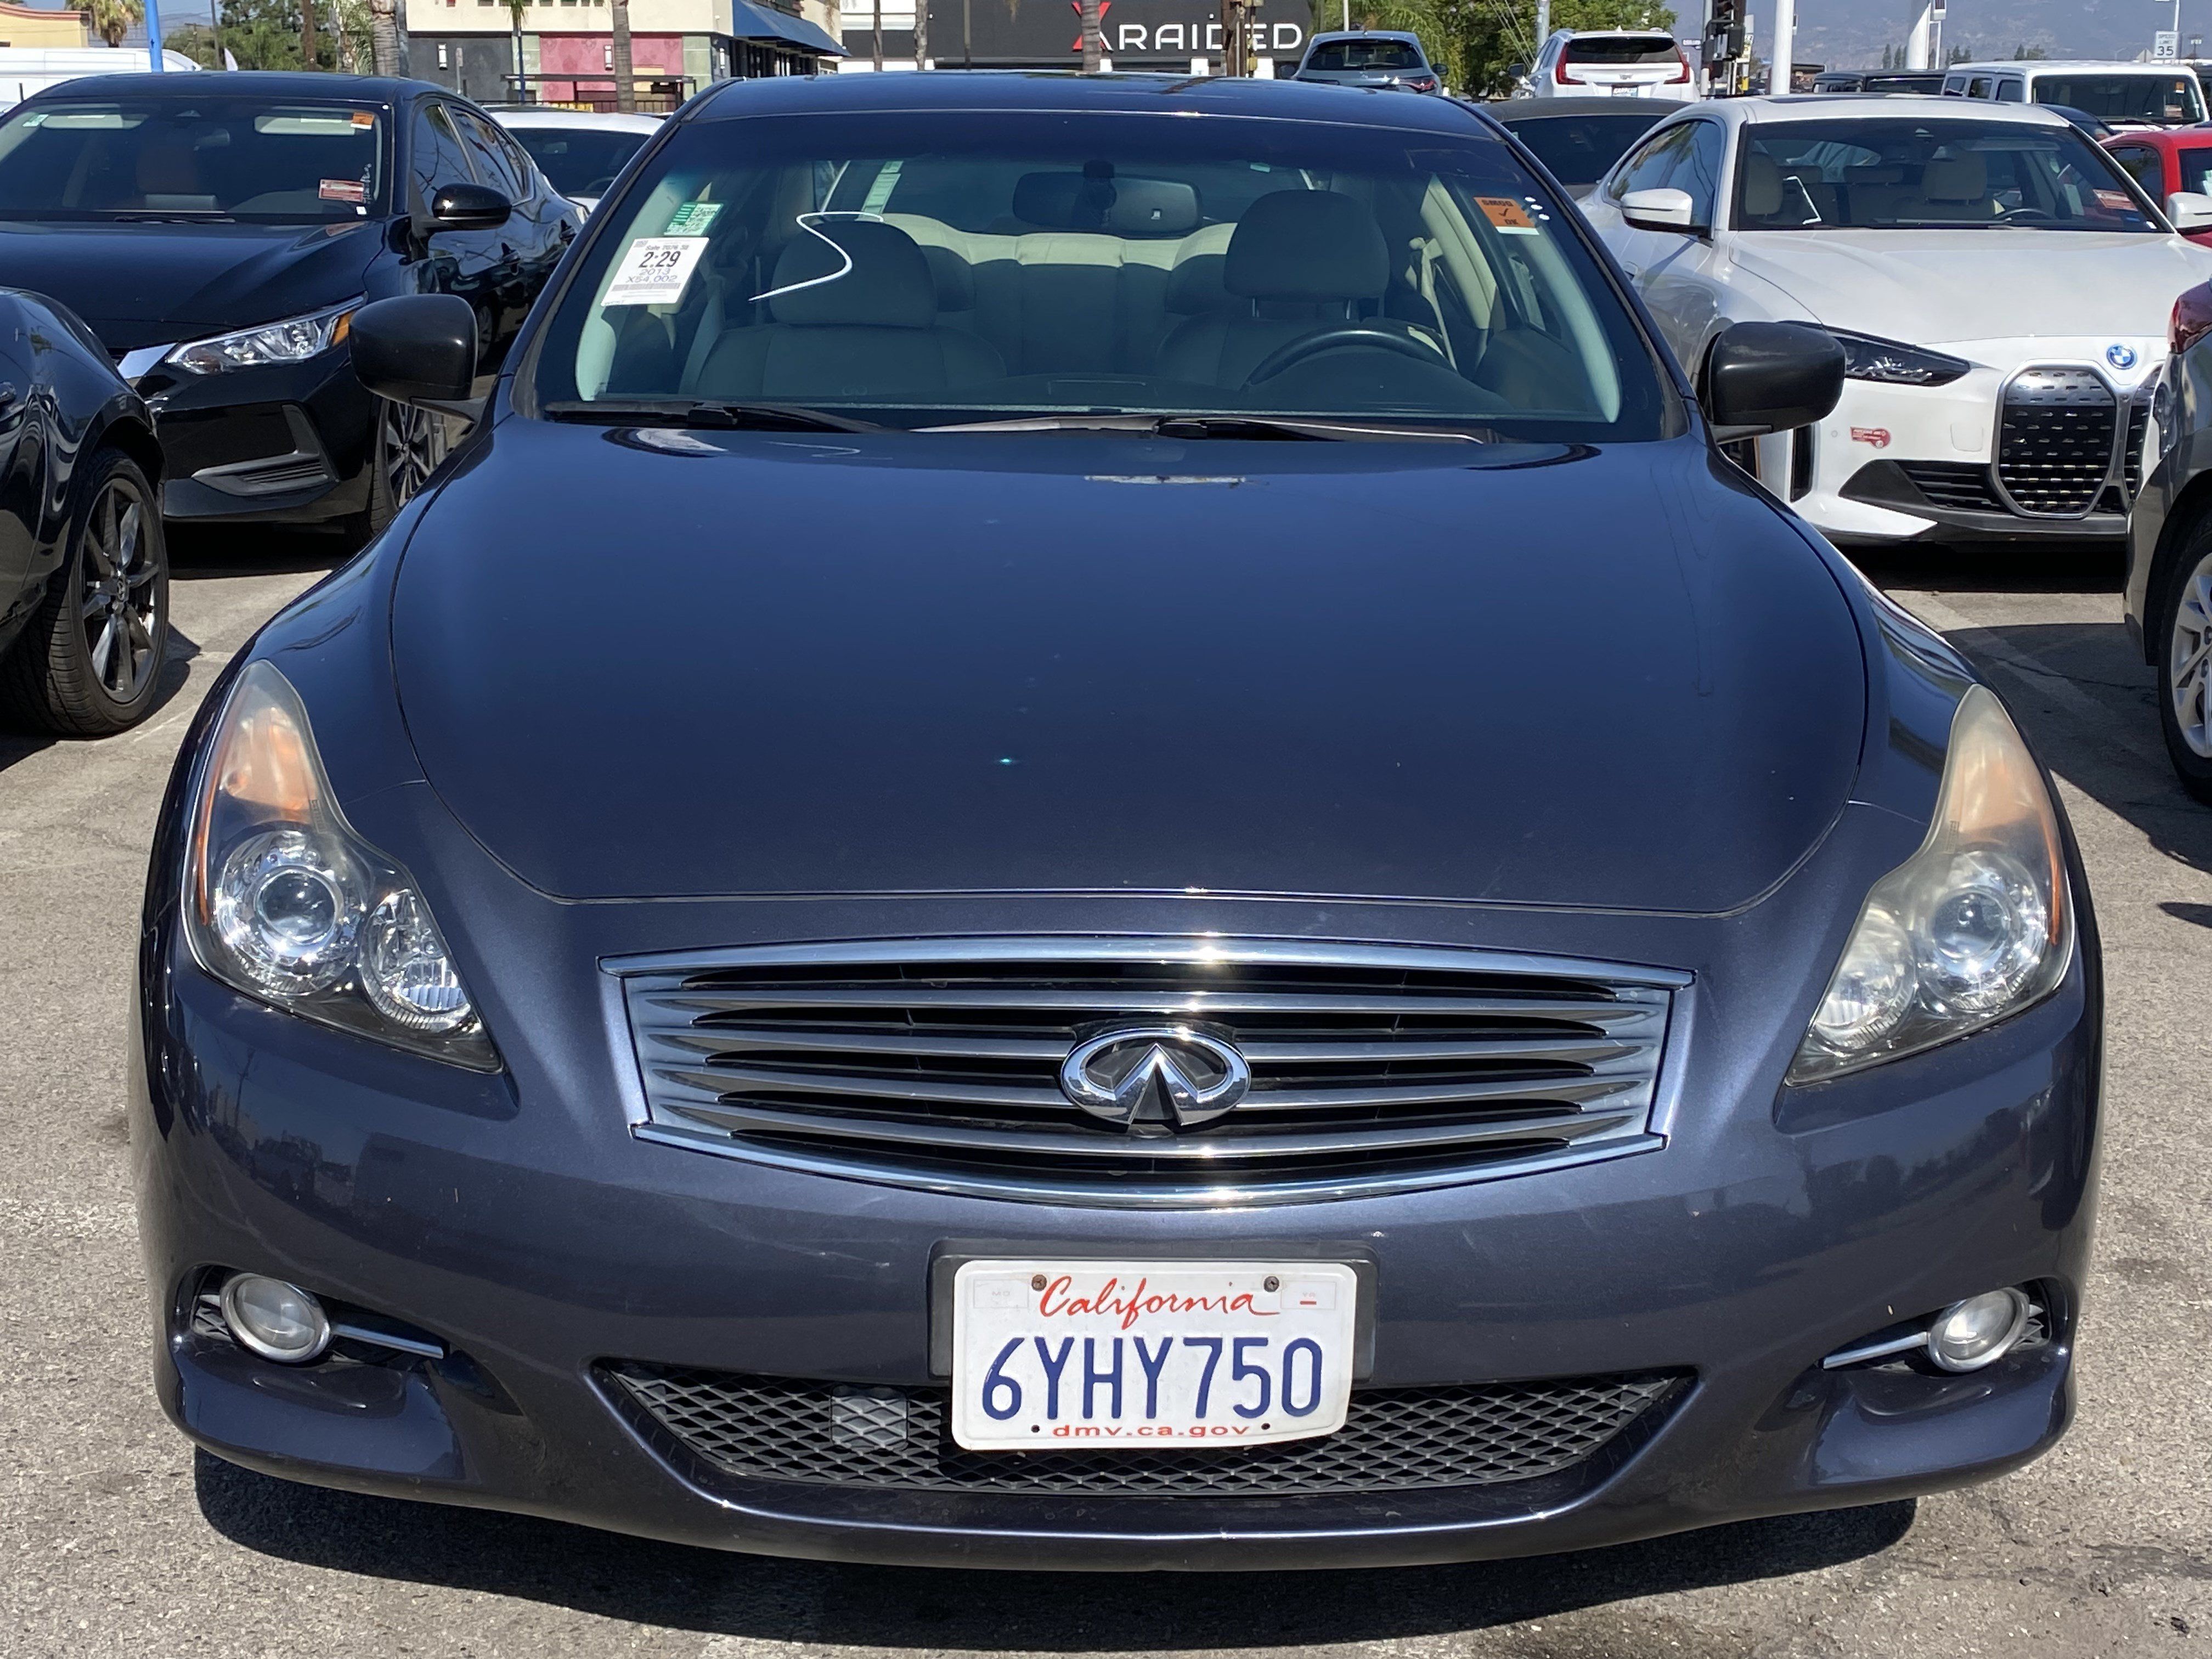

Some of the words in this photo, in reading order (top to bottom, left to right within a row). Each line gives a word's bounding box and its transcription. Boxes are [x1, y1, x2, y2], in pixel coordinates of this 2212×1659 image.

[2157, 46, 2174, 56] 35
[638, 251, 681, 268] 2:29
[1039, 1276, 1280, 1330] California
[982, 1337, 1323, 1420] 6YHY750
[1053, 1424, 1250, 1437] dmv.ca.gov
